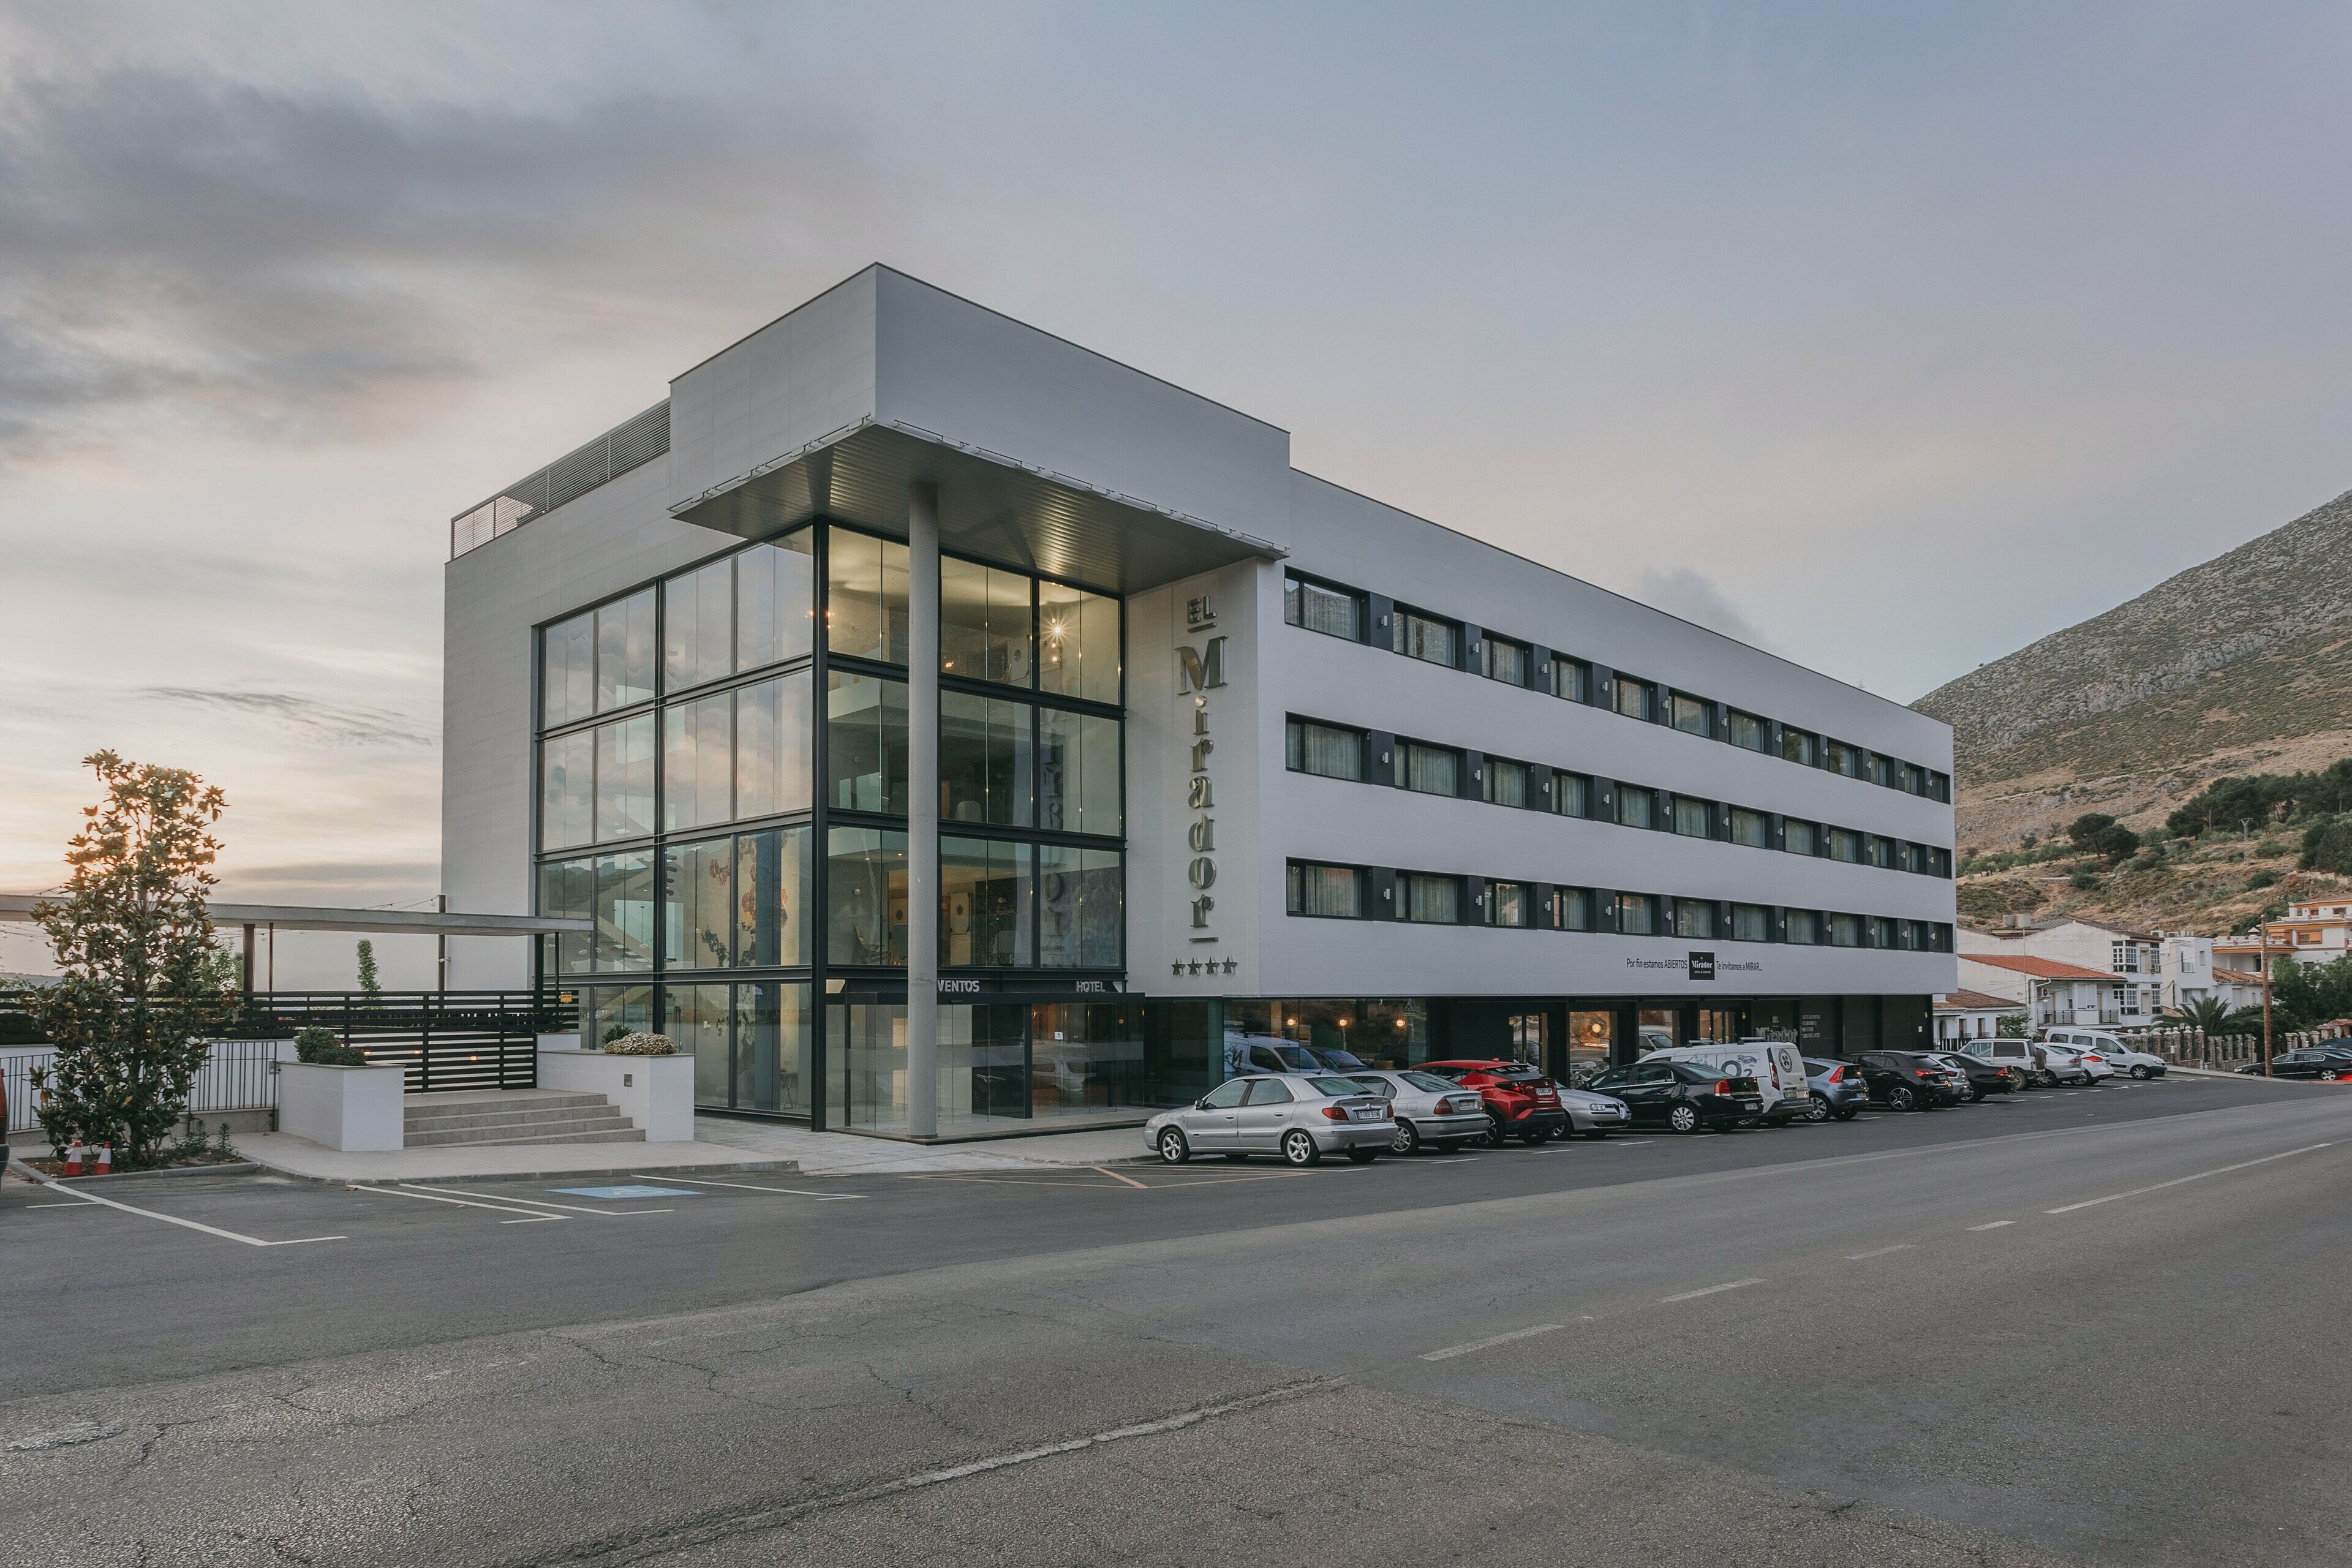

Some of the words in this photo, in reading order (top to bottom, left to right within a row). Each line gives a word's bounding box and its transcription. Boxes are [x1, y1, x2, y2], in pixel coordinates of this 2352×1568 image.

[1187, 595, 1216, 624] EL
[1173, 635, 1229, 929] Mirador
[1643, 960, 1664, 968] estamos
[1664, 959, 1687, 969] ABIERTOS
[1716, 960, 1721, 970] Te
[1722, 961, 1742, 971] invitamos
[937, 980, 979, 992] VENTOS
[1076, 981, 1106, 992] HOTEL
[1755, 1027, 1798, 1042] Mirador
